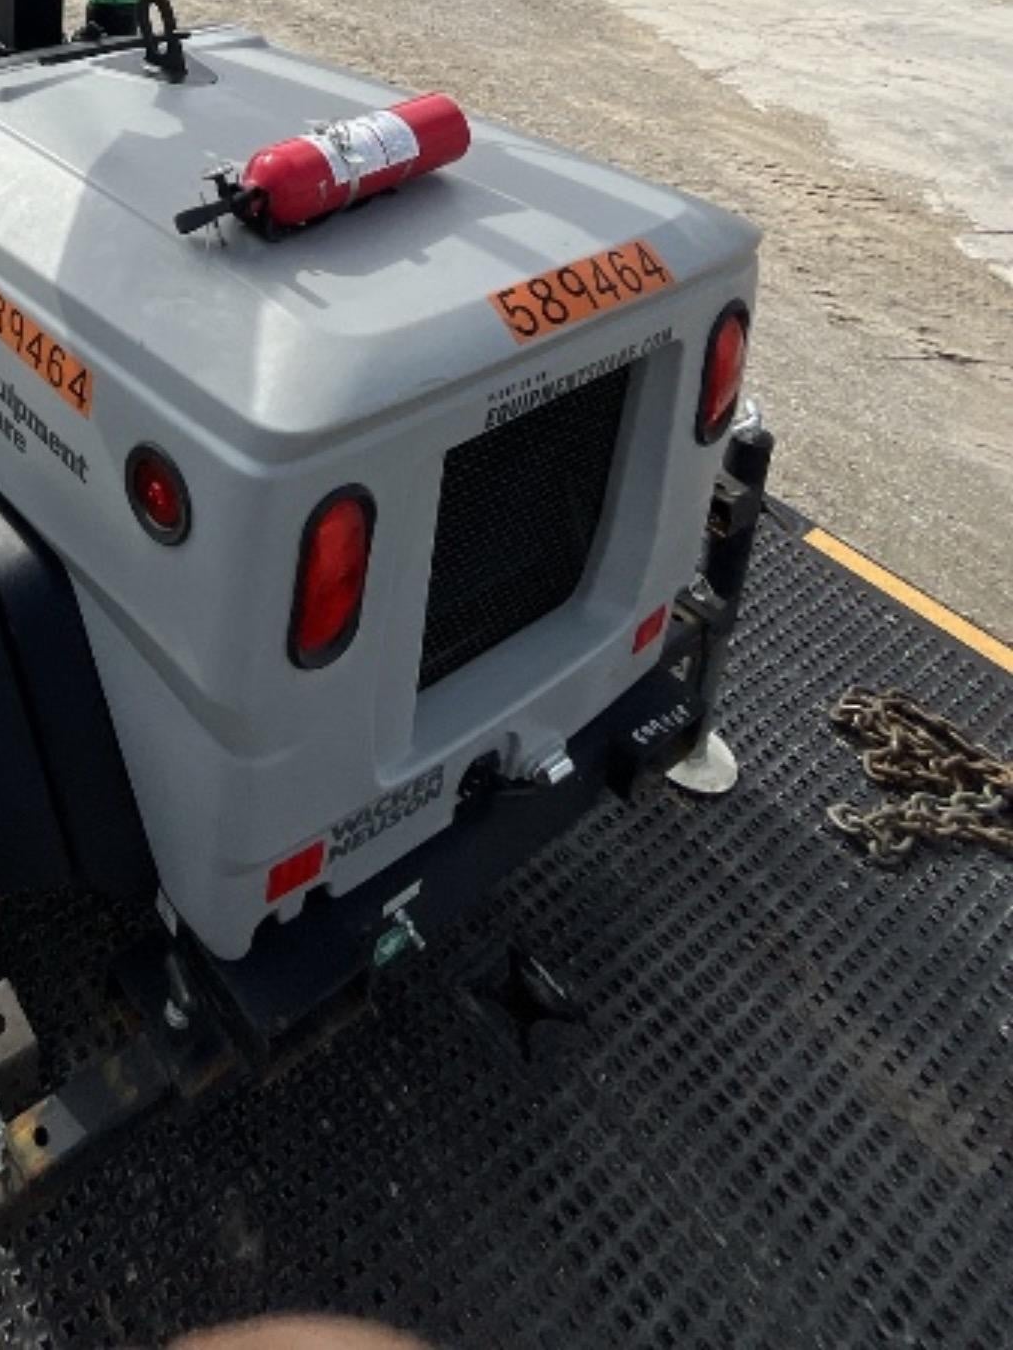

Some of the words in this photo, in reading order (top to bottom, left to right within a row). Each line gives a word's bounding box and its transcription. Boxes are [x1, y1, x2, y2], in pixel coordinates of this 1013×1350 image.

[497, 242, 666, 337] 589464
[328, 783, 442, 864] NEUSON
[331, 763, 444, 842] WACKER
